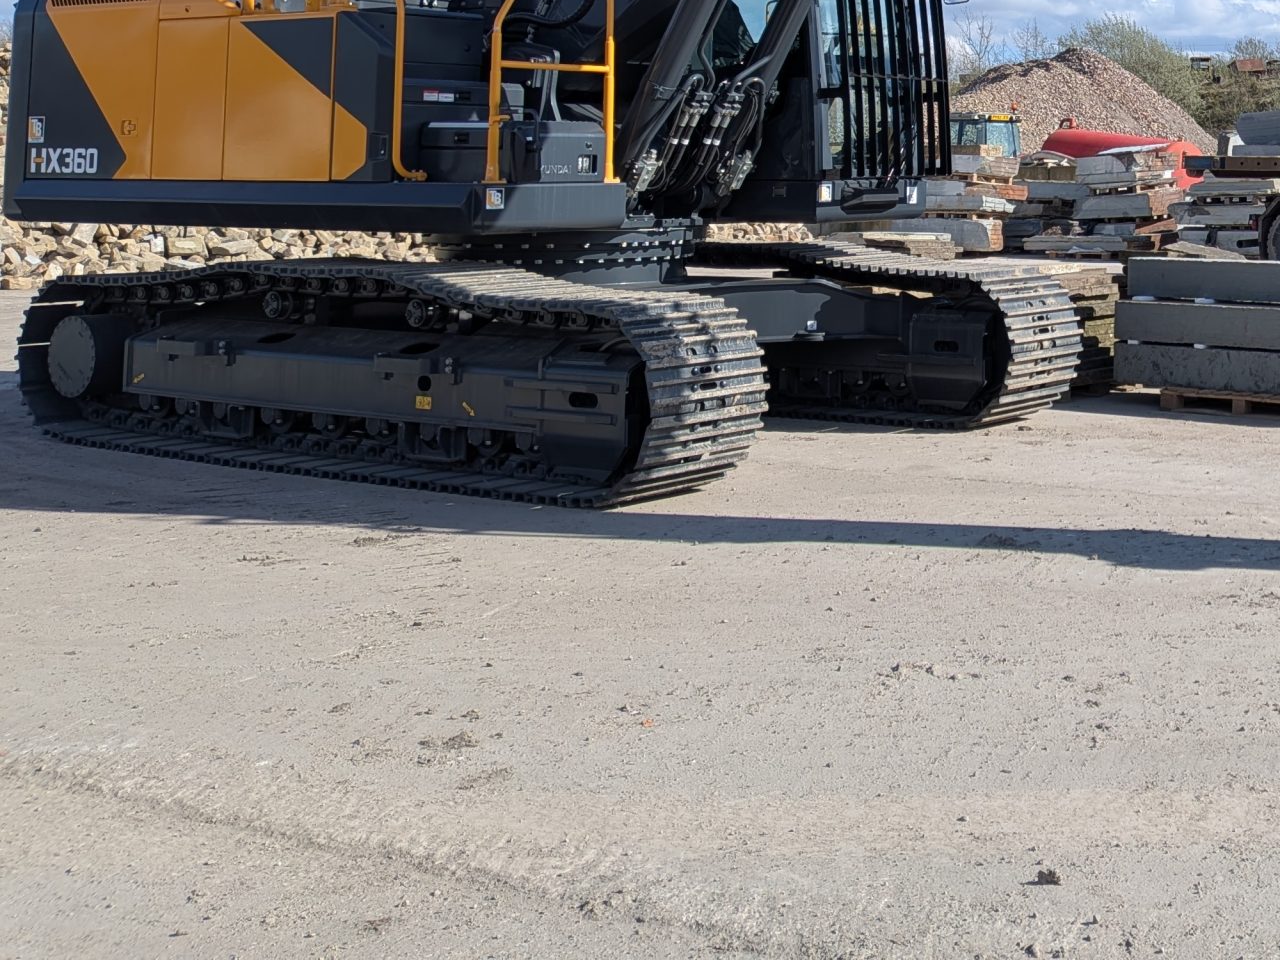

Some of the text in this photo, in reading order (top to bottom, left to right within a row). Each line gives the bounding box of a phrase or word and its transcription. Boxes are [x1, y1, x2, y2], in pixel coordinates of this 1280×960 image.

[31, 118, 42, 137] TB
[30, 147, 98, 174] HX360
[540, 164, 572, 175] YUNDAI
[488, 190, 502, 205] TB
